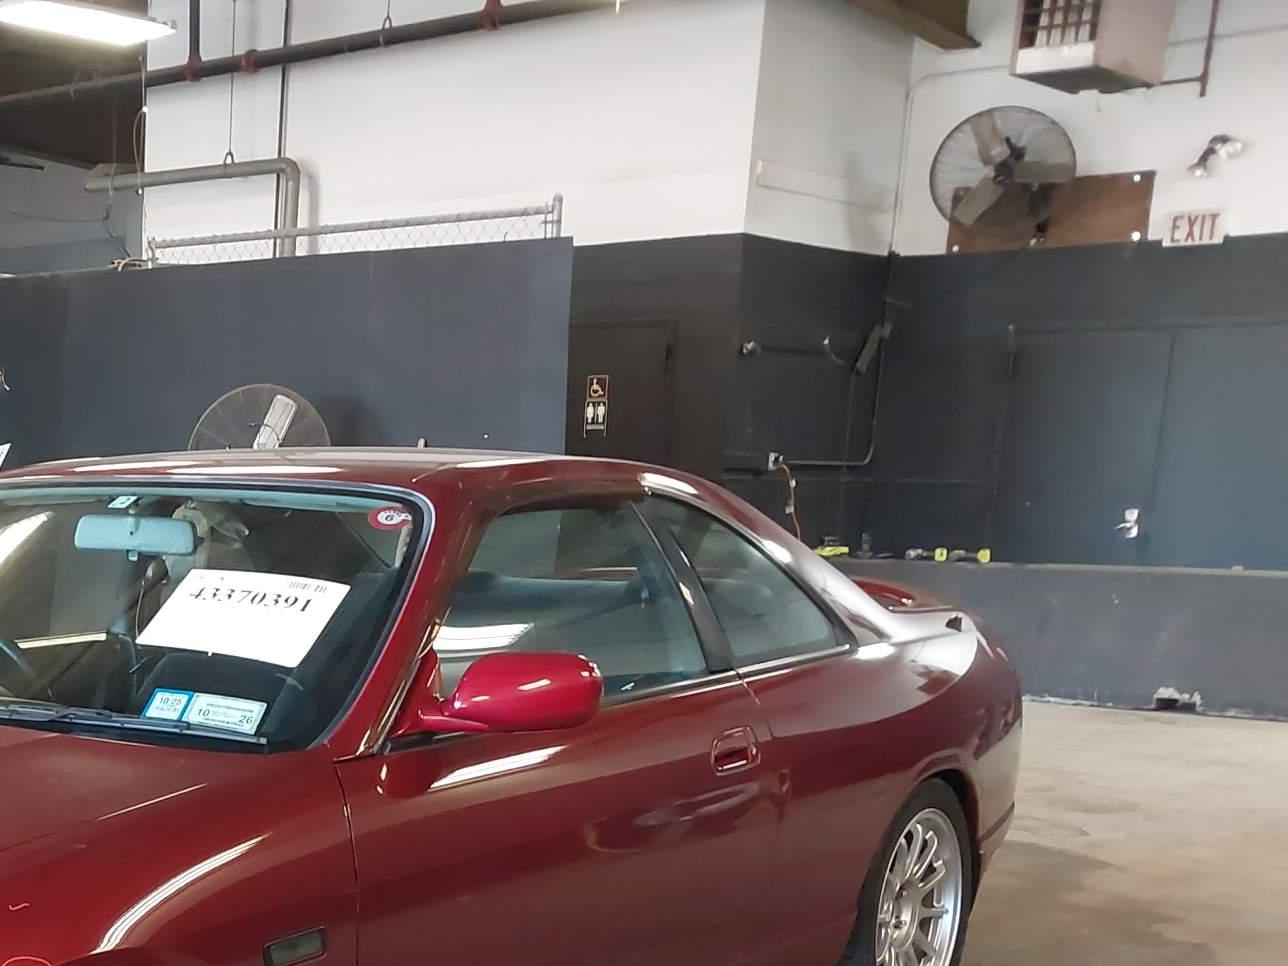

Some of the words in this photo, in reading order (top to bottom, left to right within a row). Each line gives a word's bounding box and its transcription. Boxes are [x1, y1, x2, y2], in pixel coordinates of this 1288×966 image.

[1170, 212, 1221, 244] EXIT
[189, 585, 313, 612] 43370391
[197, 708, 210, 717] 10
[238, 714, 254, 725] 26
